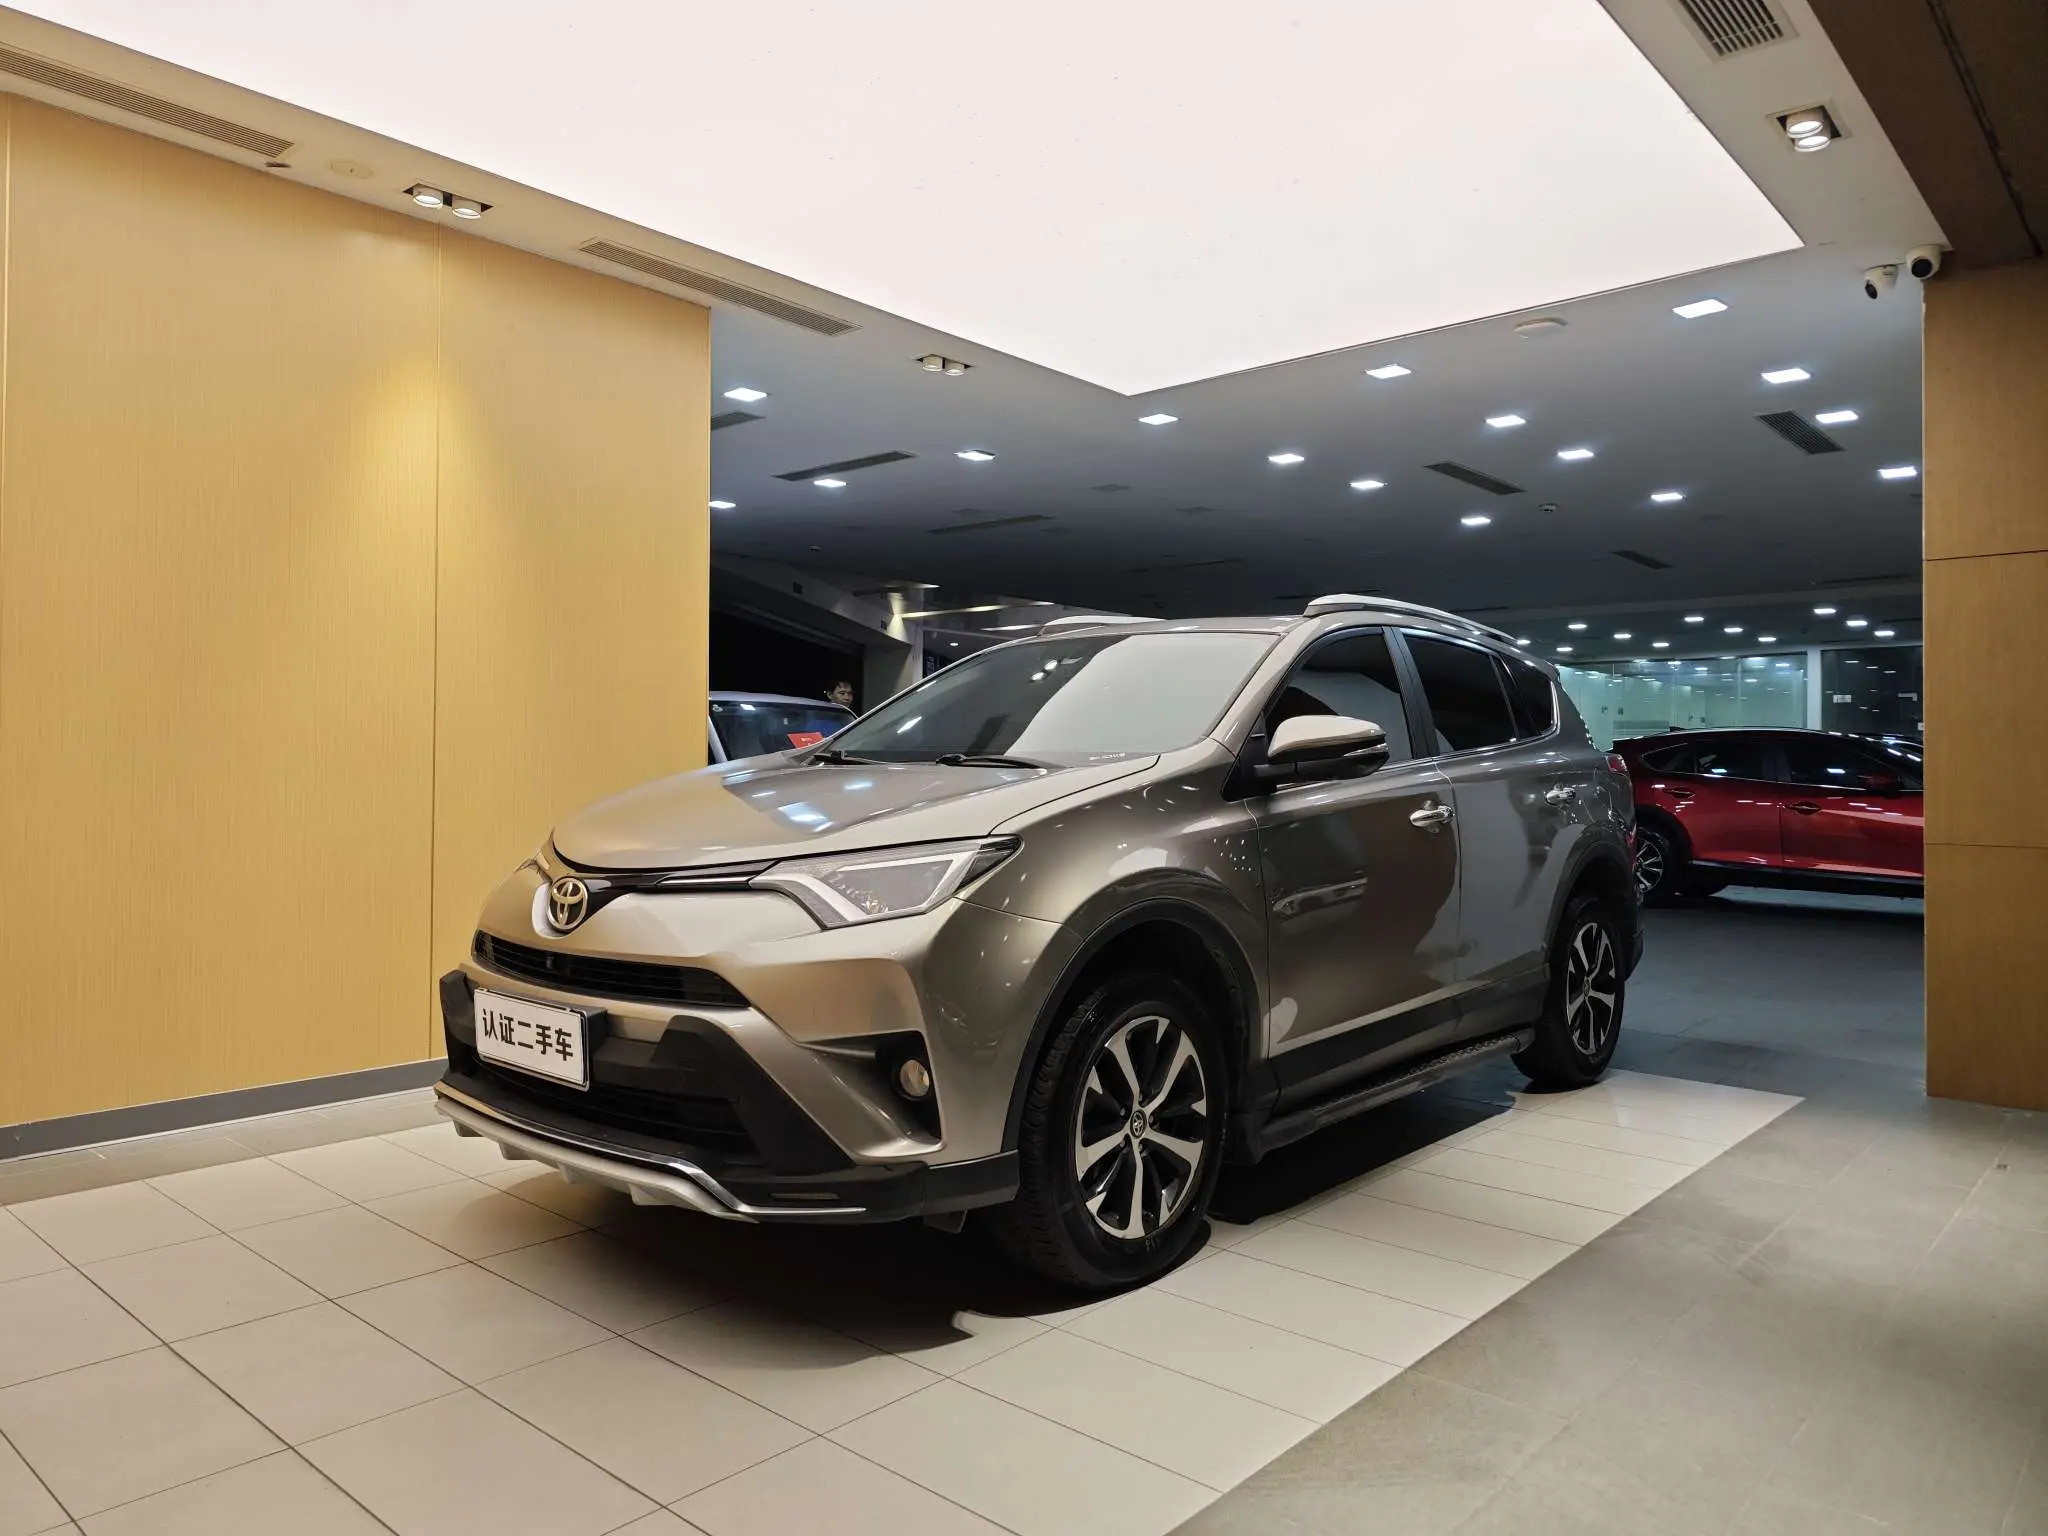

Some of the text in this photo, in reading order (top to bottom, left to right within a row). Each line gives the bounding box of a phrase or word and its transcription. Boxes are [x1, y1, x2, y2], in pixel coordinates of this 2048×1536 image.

[482, 1008, 573, 1061] 认证二手车
